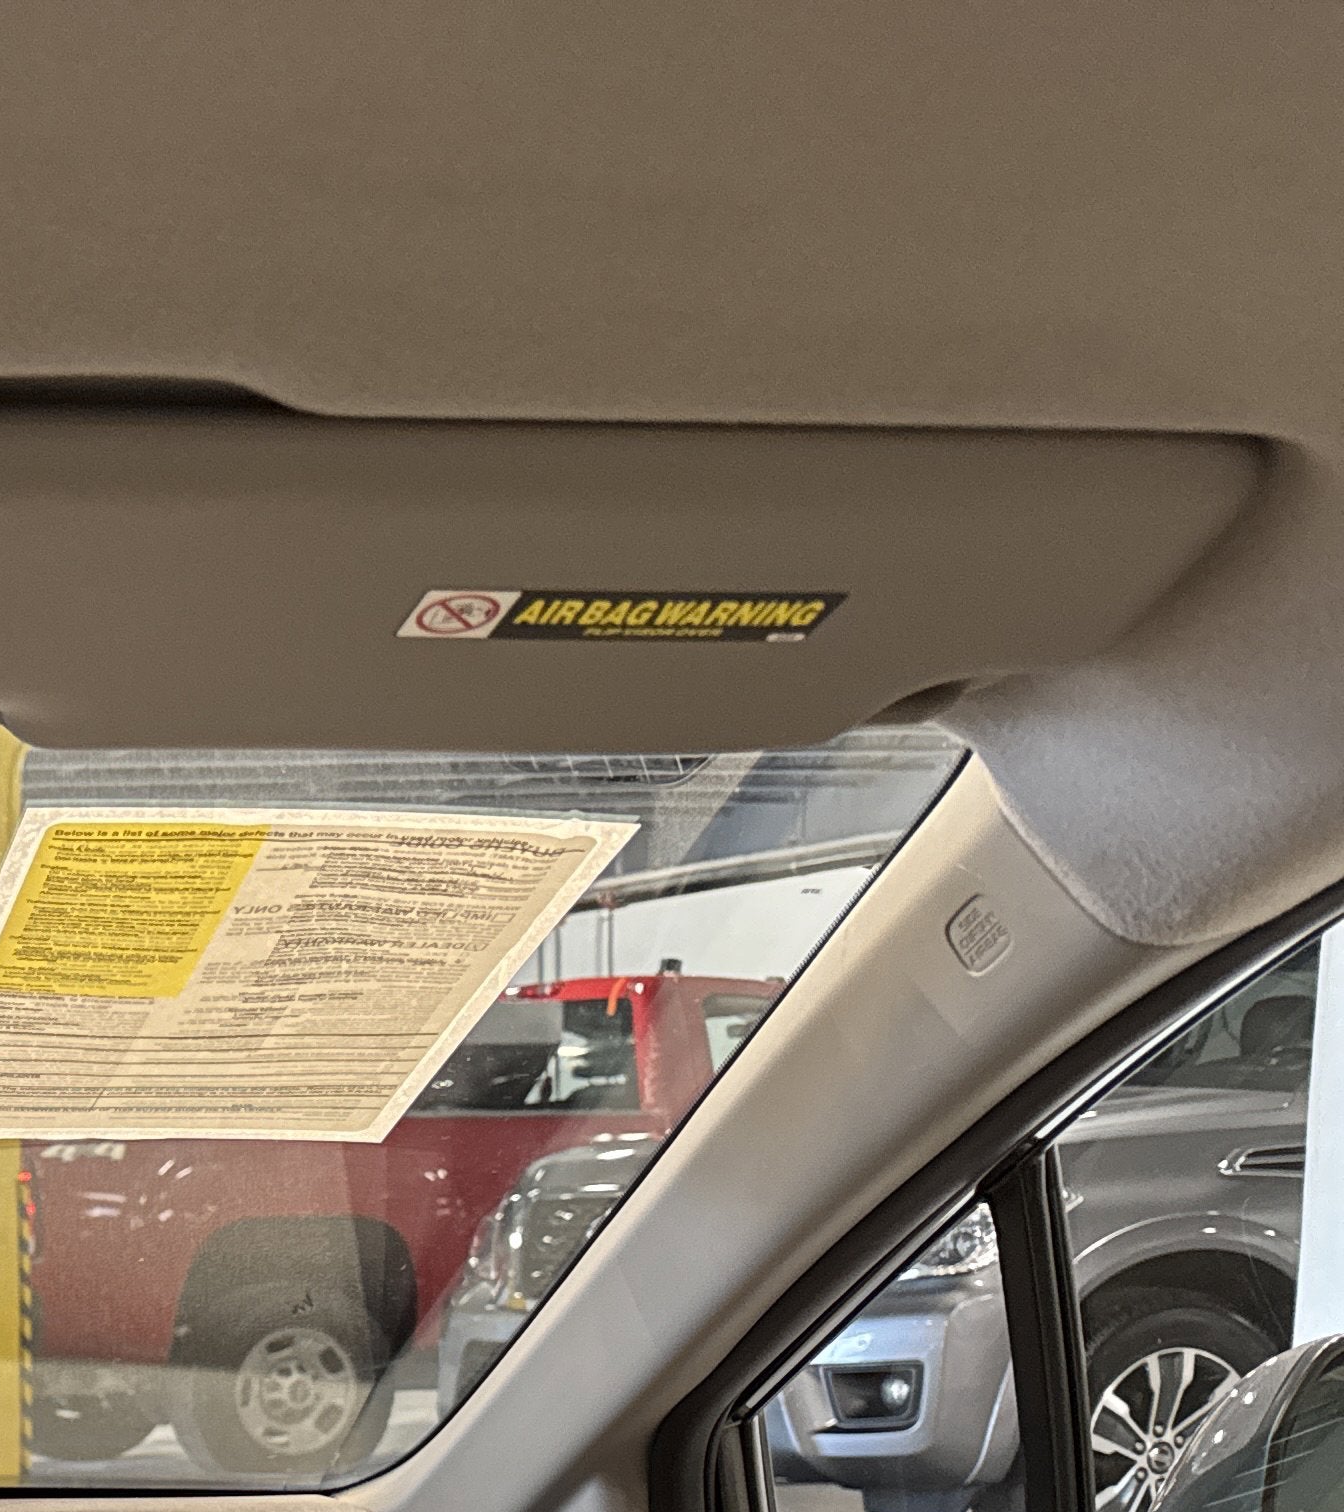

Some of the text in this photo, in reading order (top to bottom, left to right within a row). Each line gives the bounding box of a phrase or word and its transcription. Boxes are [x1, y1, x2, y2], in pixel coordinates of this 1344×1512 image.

[655, 600, 826, 626] WARNING
[54, 829, 94, 837] Below
[97, 829, 107, 837] is
[123, 829, 143, 837] list
[146, 830, 160, 838] of
[199, 830, 236, 839] major
[239, 830, 286, 838] defects
[316, 832, 345, 840] may
